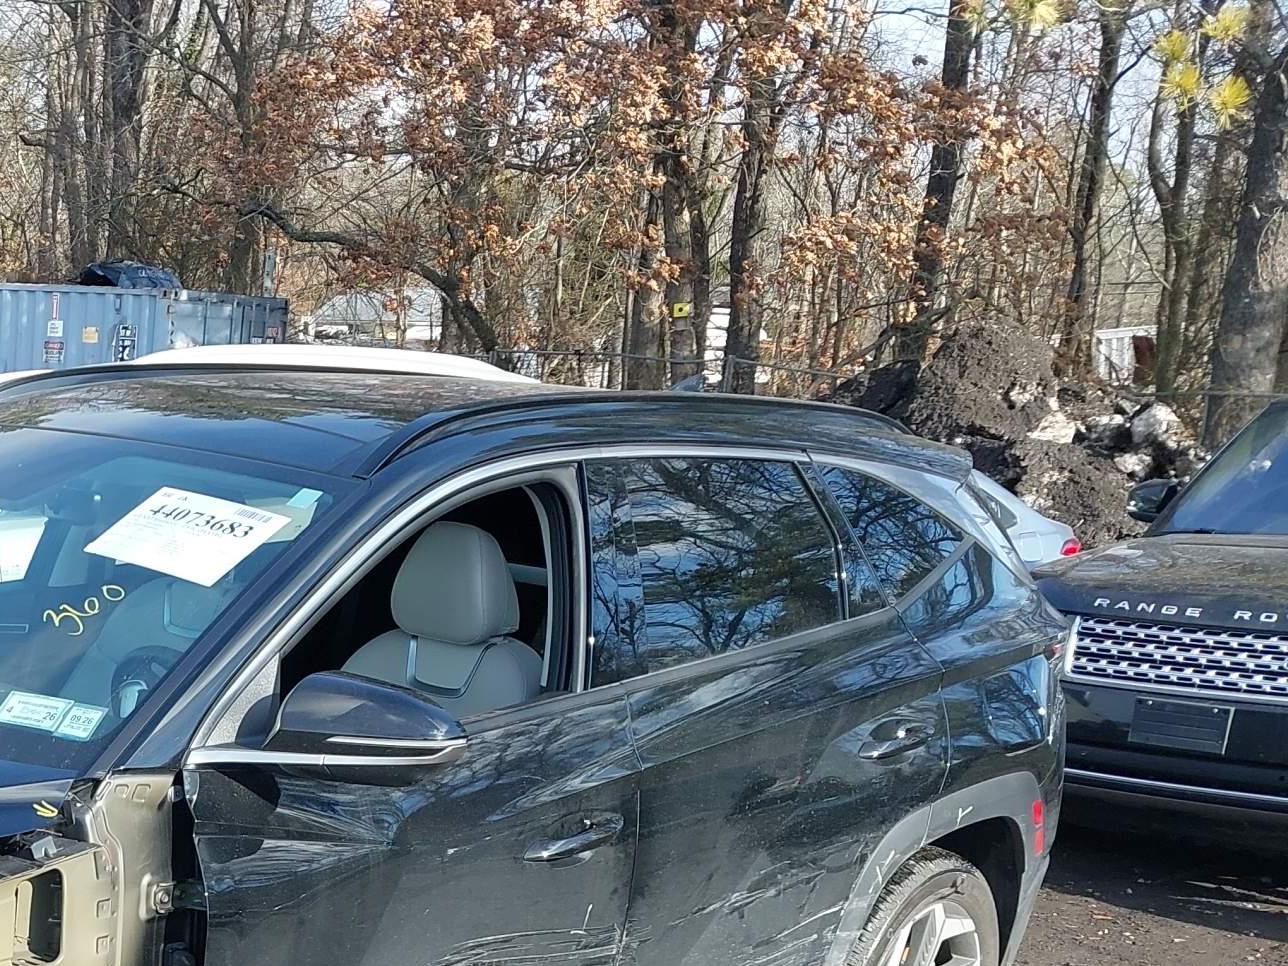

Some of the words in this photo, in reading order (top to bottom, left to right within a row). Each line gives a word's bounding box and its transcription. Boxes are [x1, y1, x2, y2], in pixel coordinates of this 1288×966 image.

[148, 503, 255, 539] 44073683
[1093, 597, 1204, 618] RANGE
[1232, 610, 1288, 624] RO
[43, 712, 58, 722] 26
